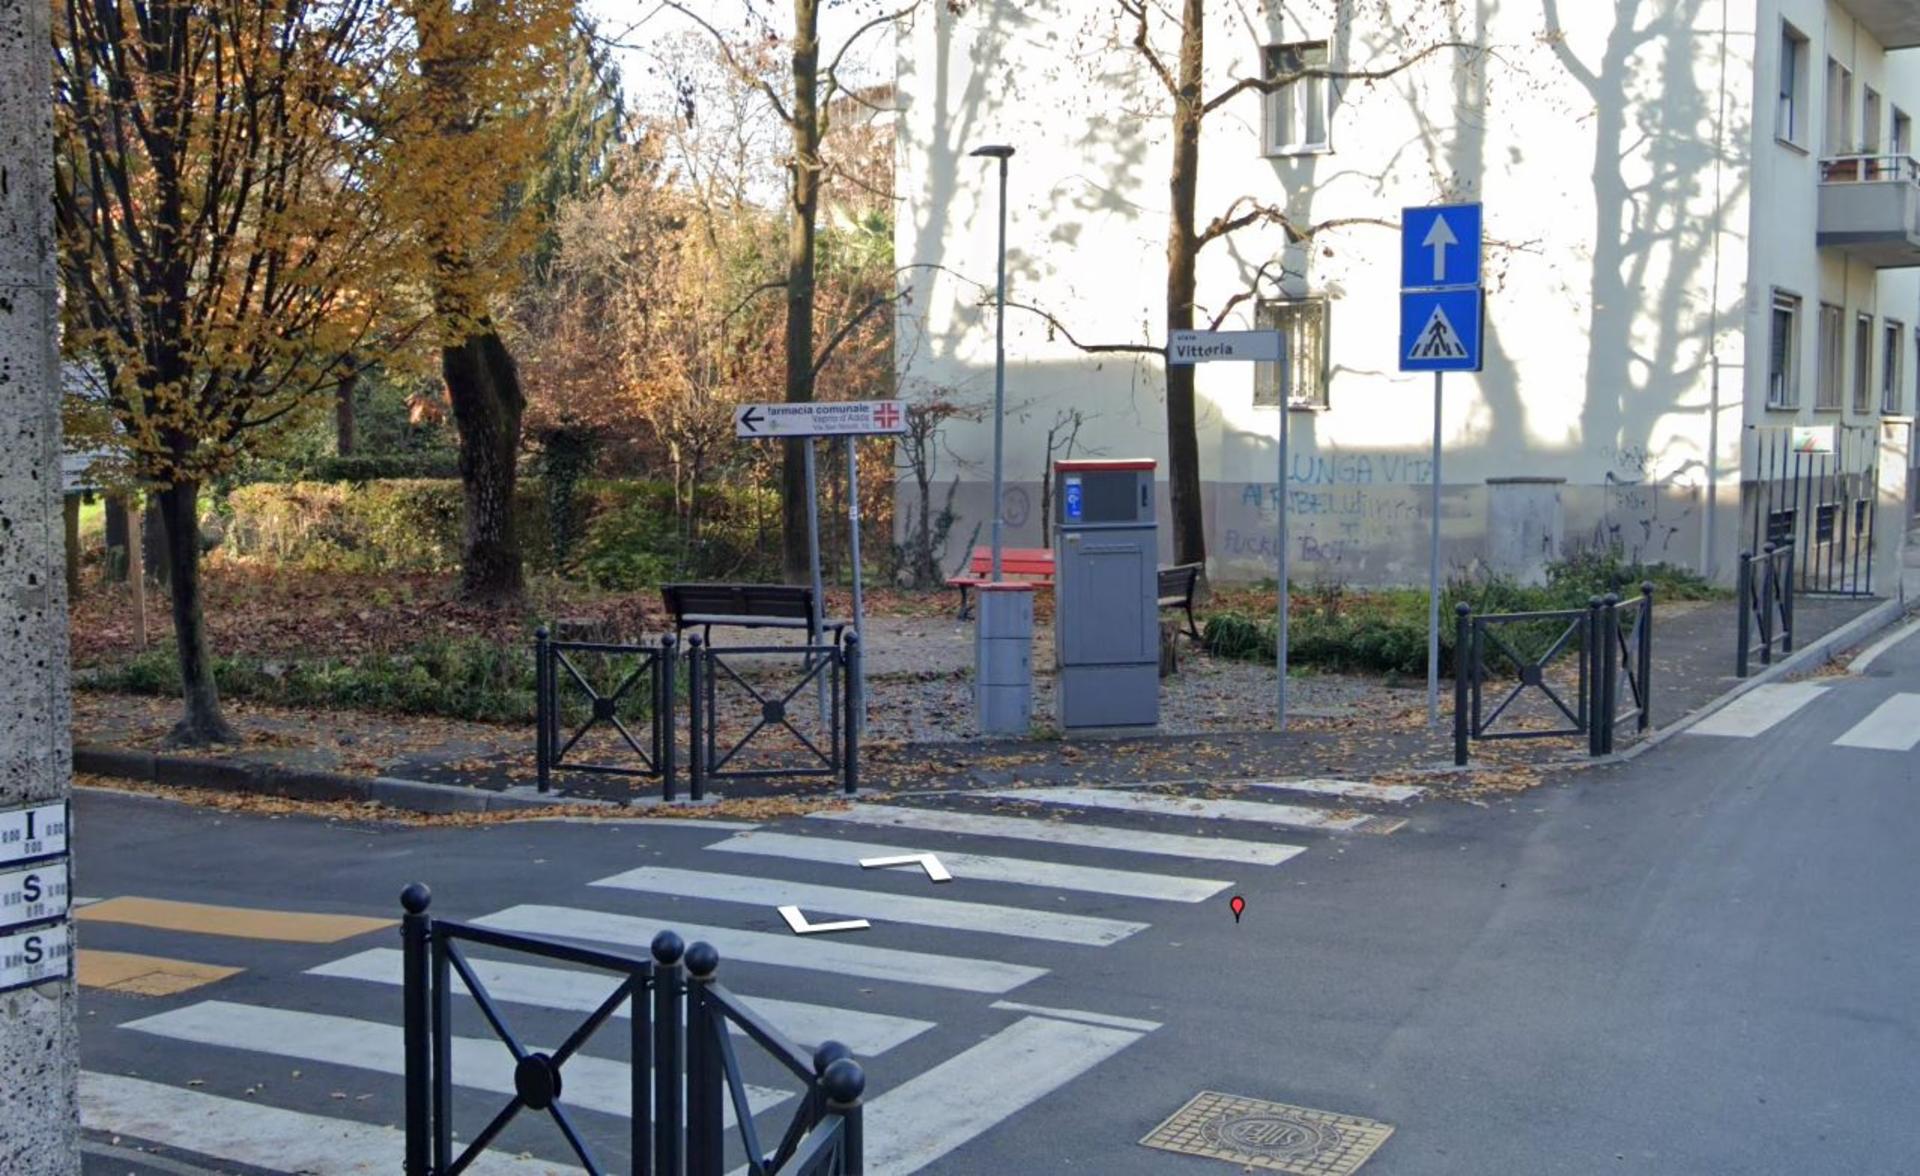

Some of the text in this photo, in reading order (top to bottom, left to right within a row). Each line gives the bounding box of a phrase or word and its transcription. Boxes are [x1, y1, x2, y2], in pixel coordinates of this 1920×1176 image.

[1177, 342, 1233, 358] Vittoria
[767, 402, 870, 416] farmacia comunale
[26, 811, 36, 840] I
[24, 874, 41, 903] S
[24, 936, 43, 965] S
